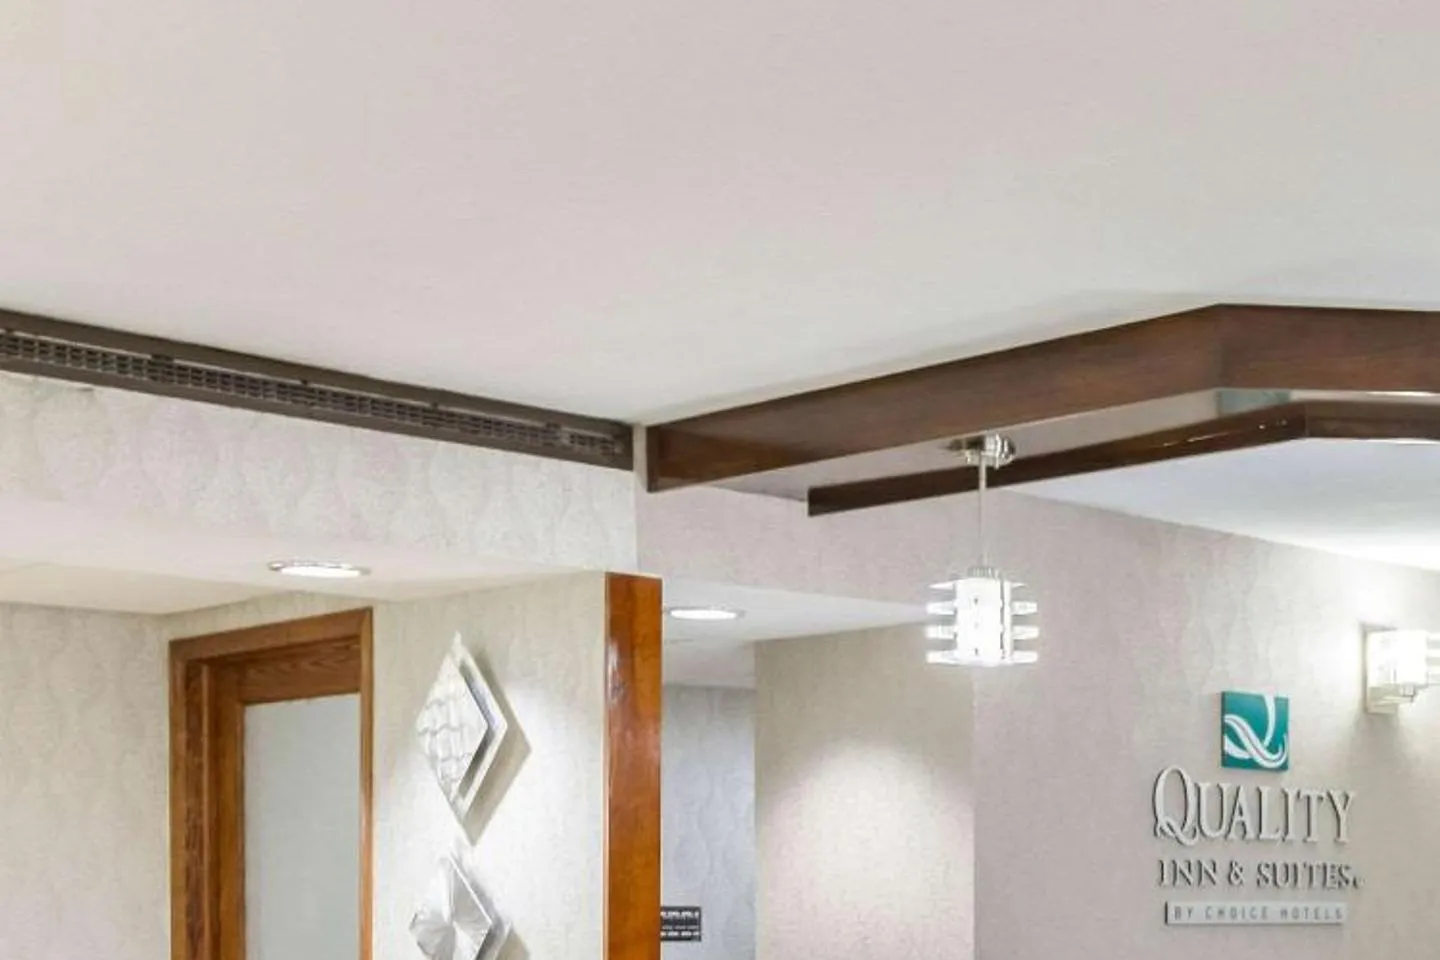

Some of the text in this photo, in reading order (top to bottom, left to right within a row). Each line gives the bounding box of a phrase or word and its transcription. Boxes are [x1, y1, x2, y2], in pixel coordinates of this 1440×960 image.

[1153, 765, 1355, 846] QUALITY
[1158, 859, 1217, 887] INN
[1228, 860, 1244, 887] &
[1174, 905, 1343, 920] BY CHOICE HOTELS
